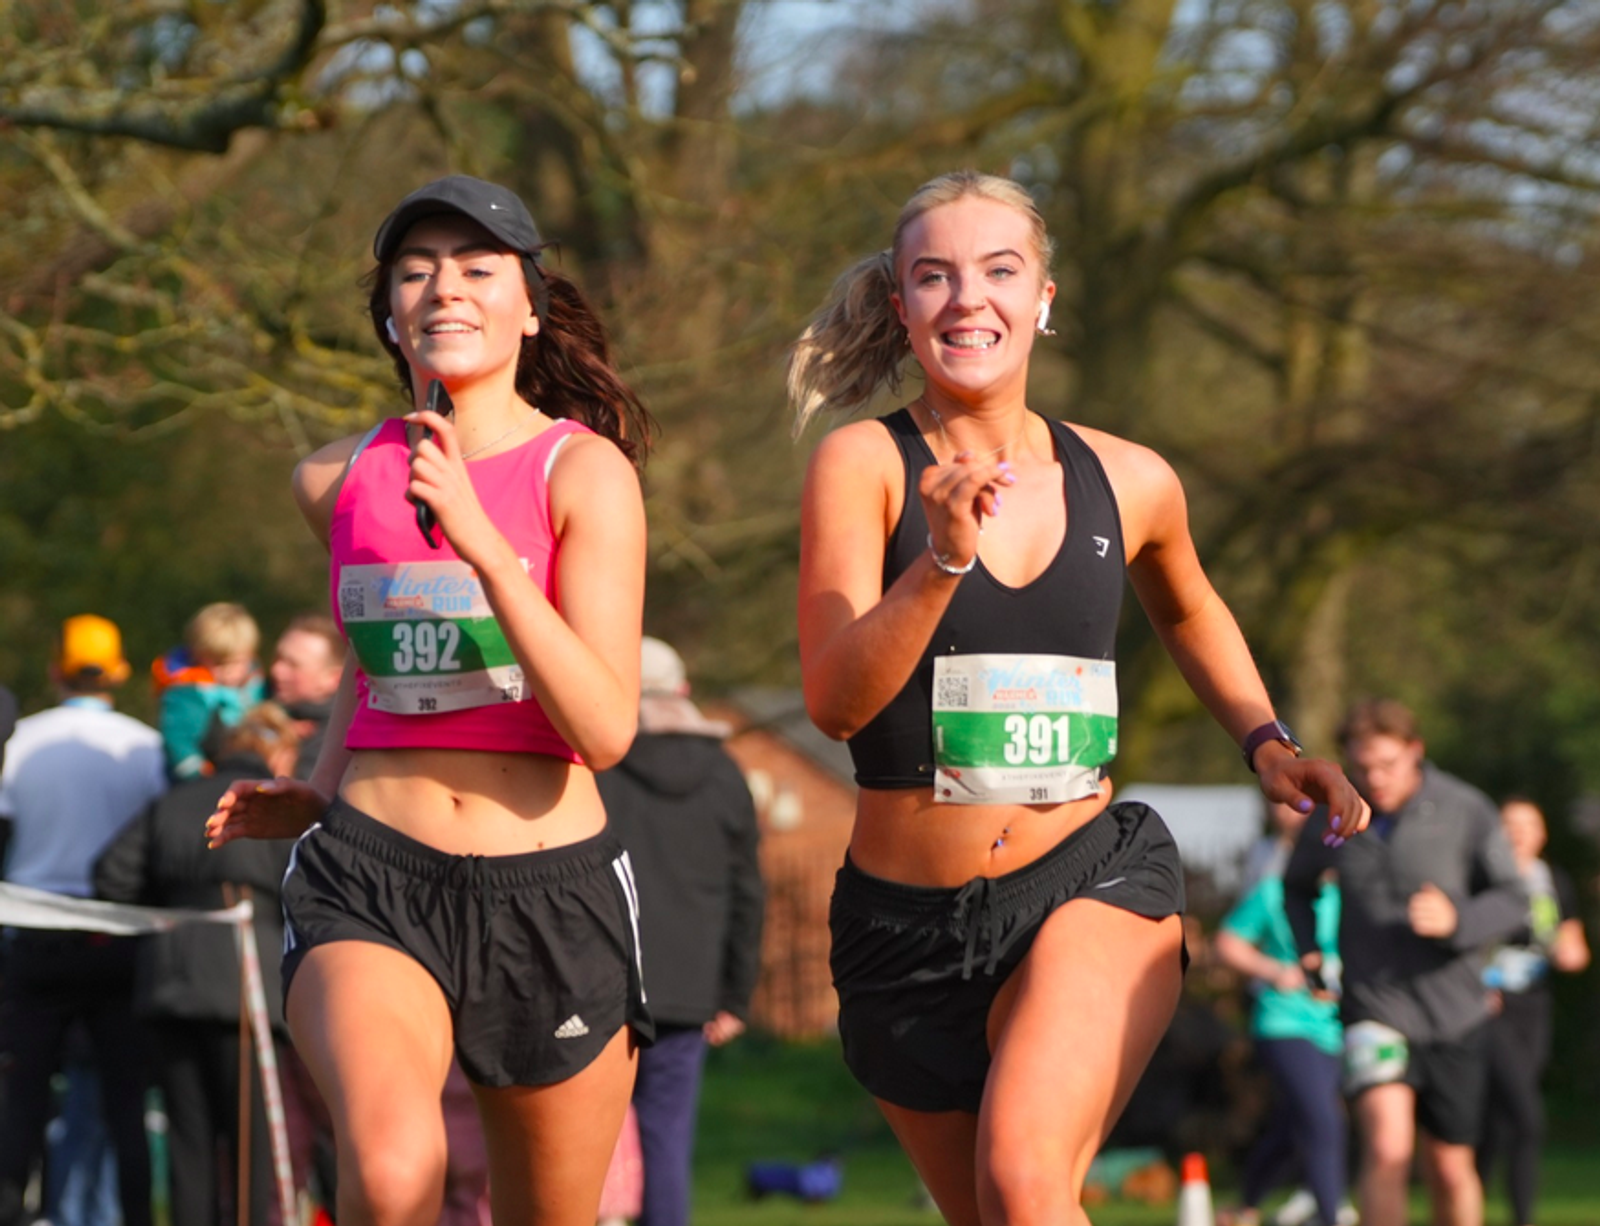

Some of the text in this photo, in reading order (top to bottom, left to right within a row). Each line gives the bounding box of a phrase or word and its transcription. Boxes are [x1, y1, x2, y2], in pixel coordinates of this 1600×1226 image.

[371, 565, 479, 604] Winter
[432, 596, 472, 612] RUN
[392, 621, 461, 673] 392
[978, 657, 1083, 697] Winter
[418, 697, 437, 711] 392
[1045, 690, 1083, 707] RUN
[1003, 714, 1070, 766] 391
[1029, 788, 1049, 800] 391
